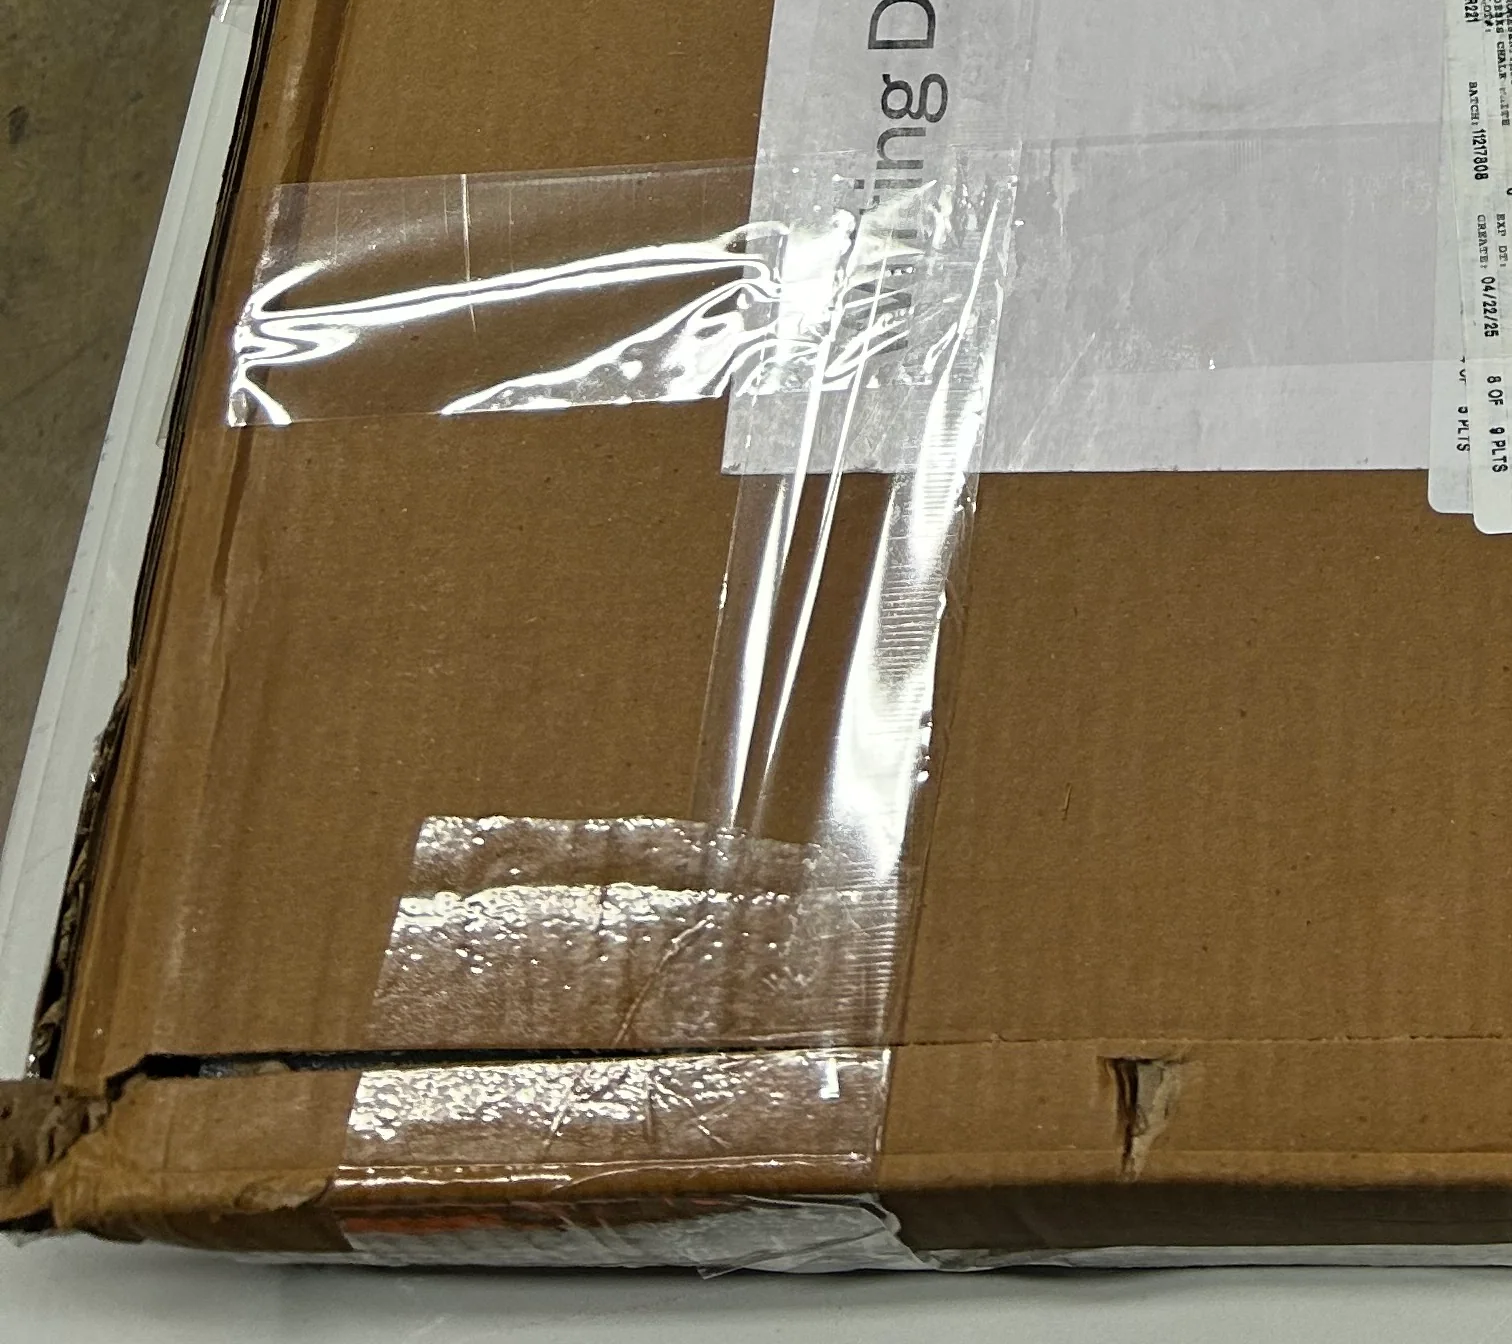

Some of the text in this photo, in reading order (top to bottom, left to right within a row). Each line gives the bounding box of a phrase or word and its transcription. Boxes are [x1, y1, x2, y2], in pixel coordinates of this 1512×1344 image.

[1497, 41, 1507, 80] CHALK
[1500, 87, 1511, 126] ITE
[1468, 81, 1489, 181] BATCH: 11217808
[1477, 214, 1489, 269] CREATE:
[1496, 213, 1508, 268] EXP DT:
[1481, 275, 1499, 338] 04/22/25
[1486, 375, 1502, 384] 8
[1487, 388, 1504, 406] OF
[1491, 439, 1509, 473] PLTS
